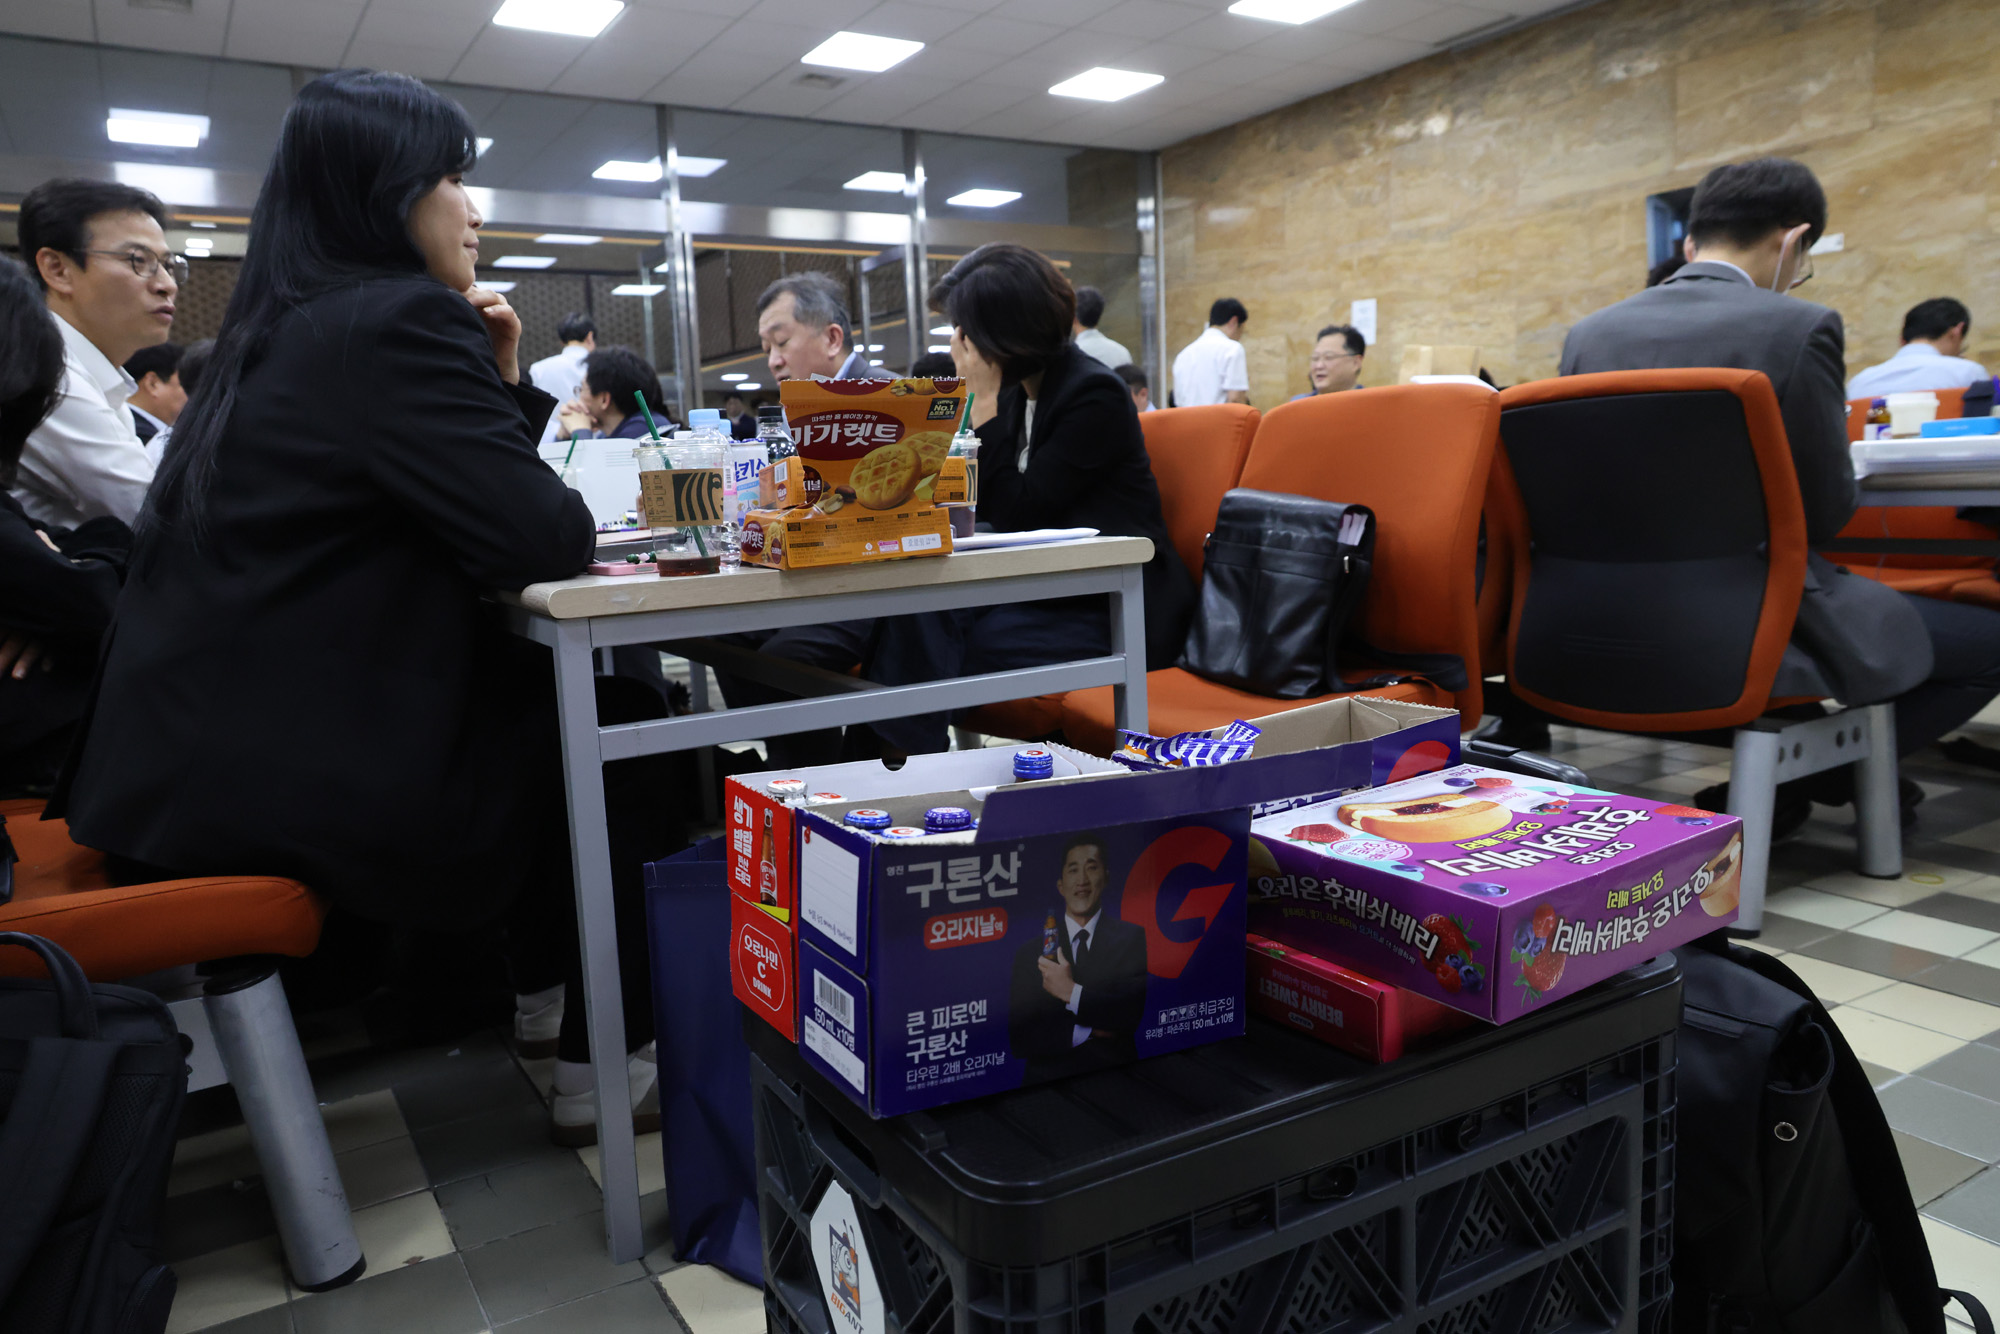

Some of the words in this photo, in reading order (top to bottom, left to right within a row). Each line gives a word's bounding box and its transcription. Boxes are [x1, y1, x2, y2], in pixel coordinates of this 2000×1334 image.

[811, 414, 833, 423] 따뜻한
[843, 413, 863, 421] 베이킹
[864, 413, 878, 422] 쿠키
[790, 423, 898, 447] 마가렛트
[734, 795, 753, 829] 생기
[734, 828, 753, 859] 발랄
[1455, 834, 1500, 851] 베리
[1493, 819, 1544, 842] 요거트
[1574, 841, 1636, 866] 오리온
[886, 865, 904, 876] 영진
[906, 851, 1021, 909] 구론산
[1120, 825, 1235, 979] G
[1606, 890, 1630, 910] 베리
[1631, 869, 1665, 904] 요거트
[1651, 862, 1711, 927] 오리온
[1257, 874, 1322, 901] 오리온
[1323, 877, 1439, 960] 후레쉬베리
[1550, 905, 1652, 957] 후레쉬베리
[744, 934, 778, 971] 오로나민
[757, 961, 766, 979] C
[752, 976, 772, 999] DRINK
[1258, 977, 1299, 1008] SWEET
[814, 1006, 825, 1028] 150
[826, 1017, 836, 1036] mL
[906, 1010, 925, 1036] 큰
[931, 999, 987, 1029] 피로엔
[1198, 995, 1235, 1016] 취급주의
[1301, 994, 1344, 1029] BERRY
[1192, 1018, 1204, 1030] 150
[1204, 1016, 1215, 1027] mL
[906, 1029, 968, 1064] 구론산
[906, 1065, 939, 1083] 타우린
[942, 1060, 961, 1075] 2배
[964, 1051, 1006, 1072] 오리지날
